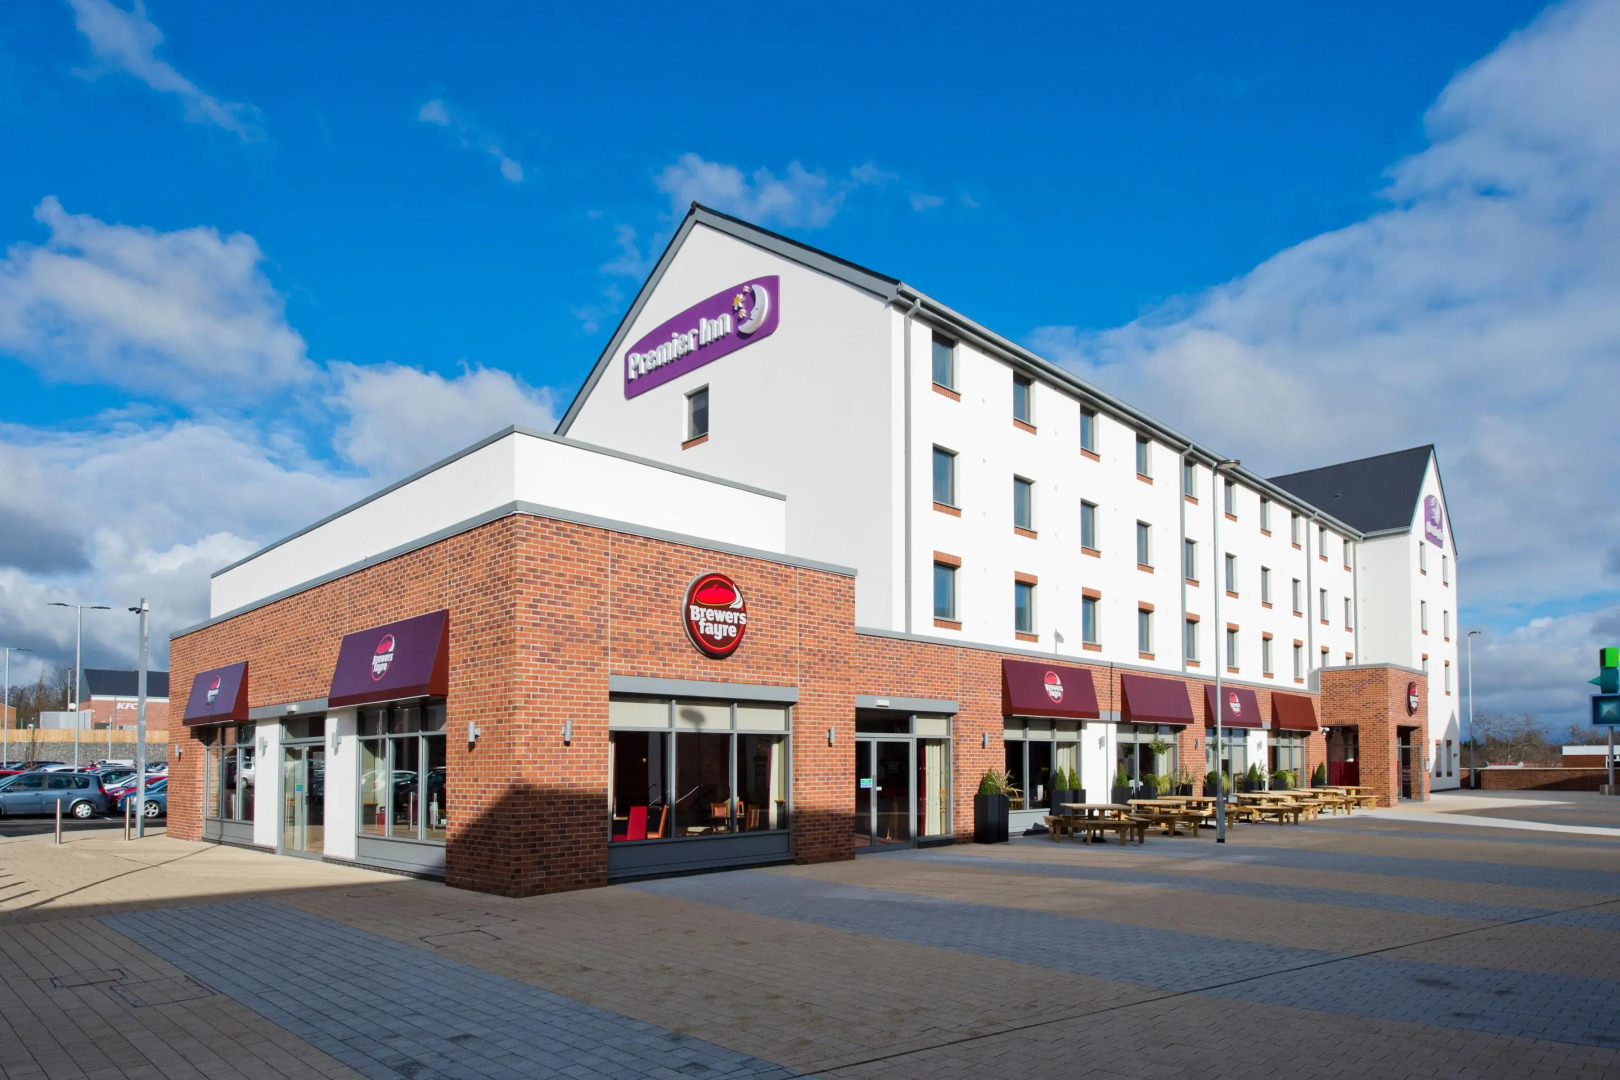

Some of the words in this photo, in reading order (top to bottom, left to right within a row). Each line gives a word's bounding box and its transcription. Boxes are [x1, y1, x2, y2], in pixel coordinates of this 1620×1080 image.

[628, 328, 698, 379] Premier
[699, 313, 731, 345] Inn
[690, 605, 747, 625] Brewers
[698, 617, 737, 640] fayre
[117, 702, 139, 710] KFC
